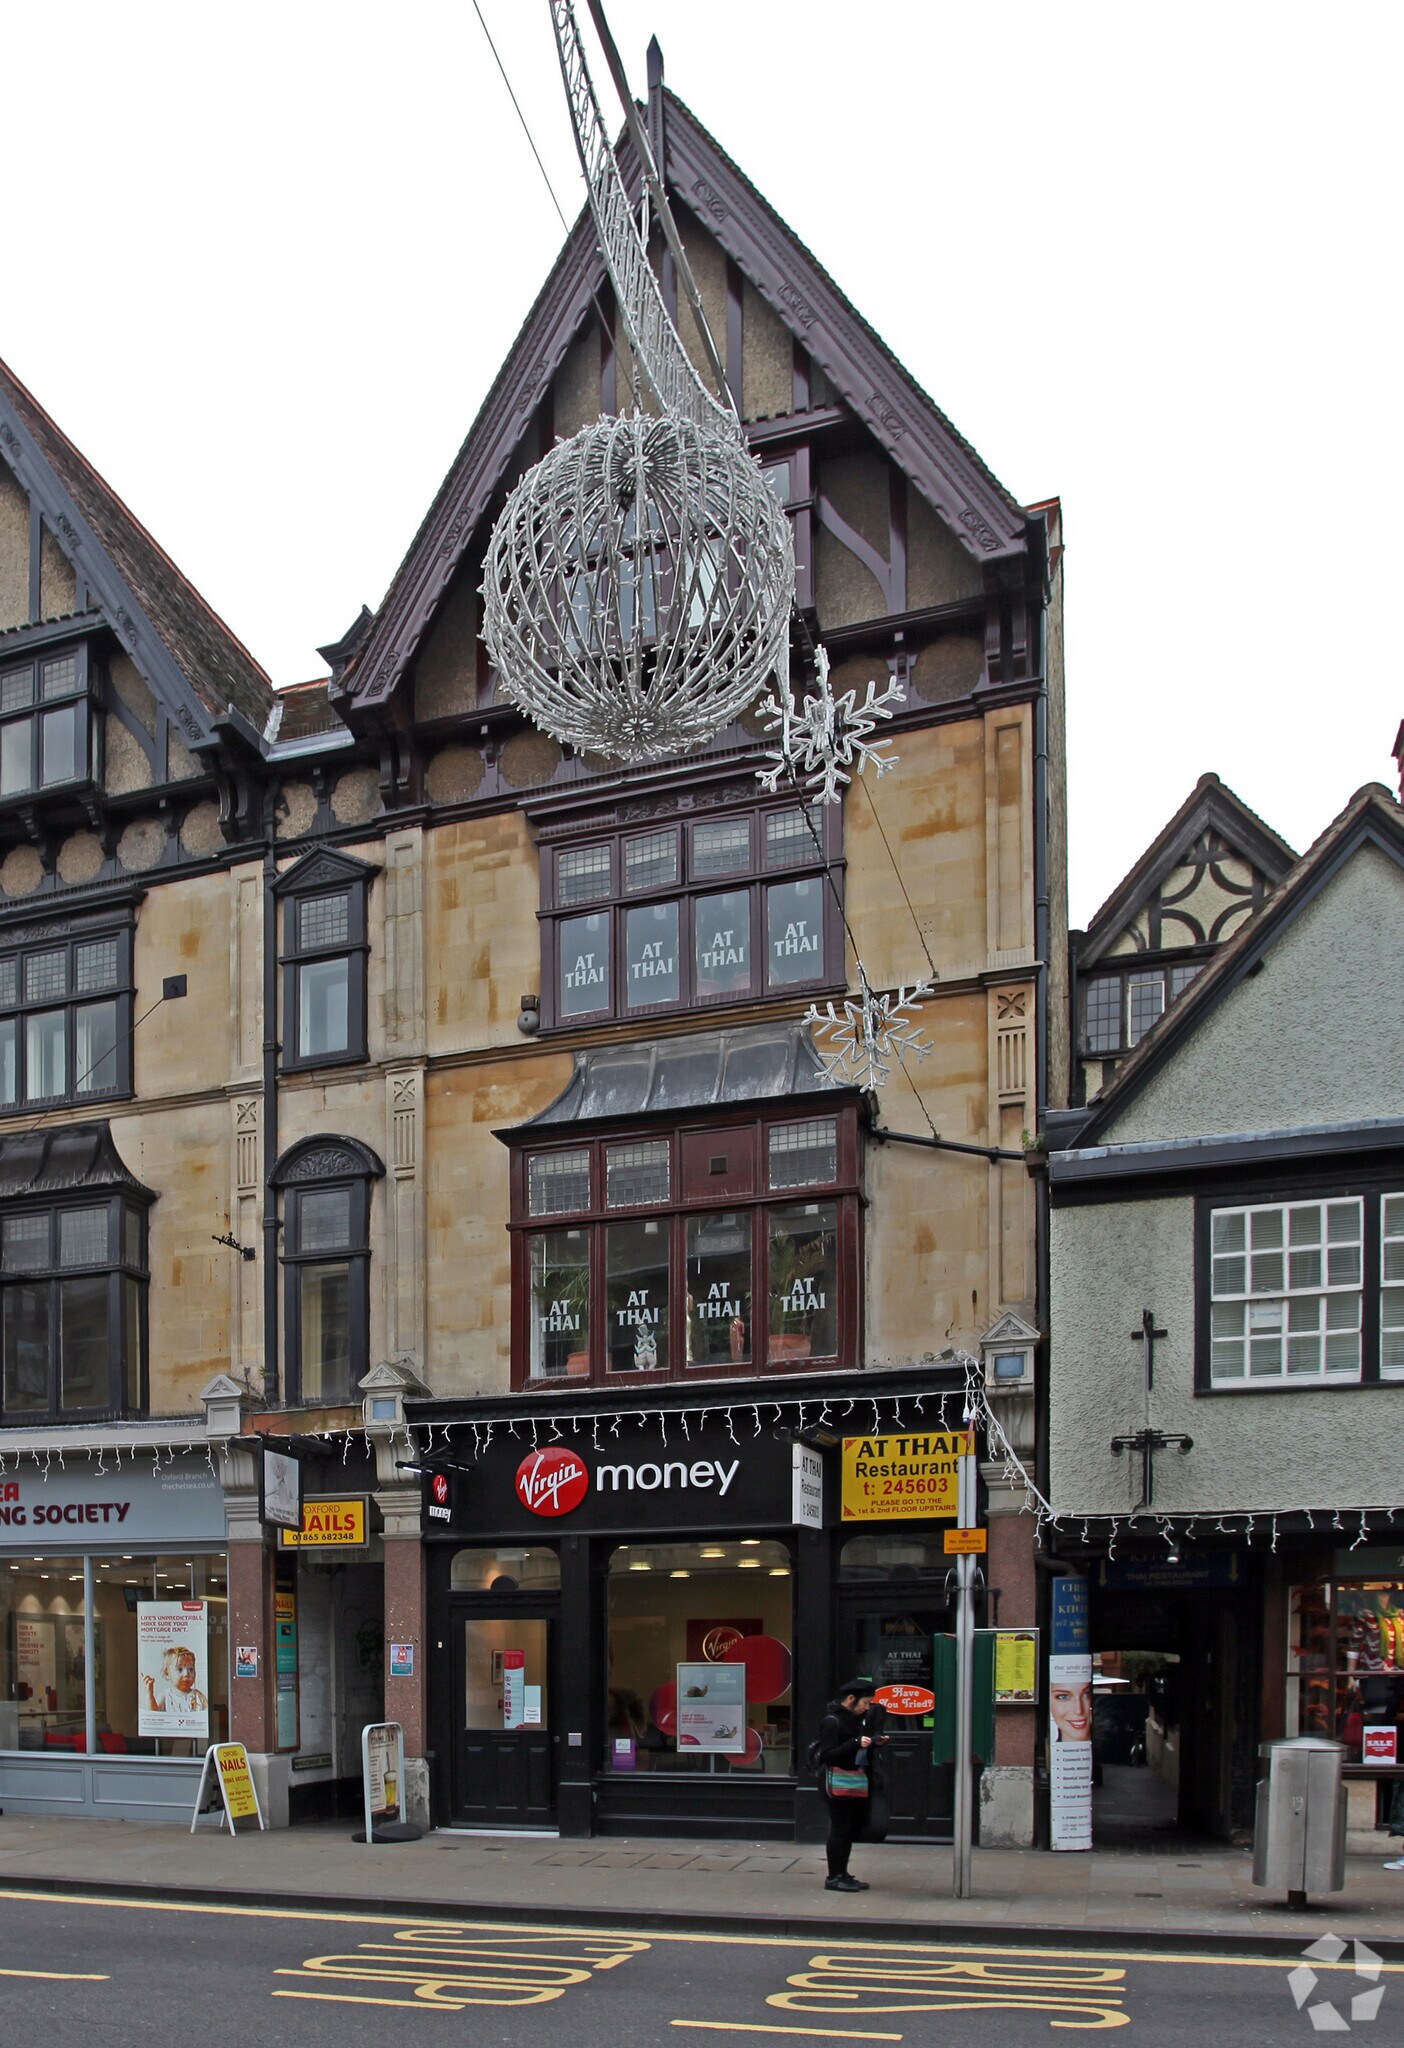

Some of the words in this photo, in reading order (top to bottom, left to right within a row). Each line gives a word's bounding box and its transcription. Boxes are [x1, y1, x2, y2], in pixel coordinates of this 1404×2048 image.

[712, 930, 734, 949] AT
[785, 920, 808, 940] AT
[642, 941, 663, 961] AT
[774, 934, 819, 957] THAI
[574, 953, 595, 972] AT
[701, 947, 745, 968] THAI
[564, 967, 604, 988] THAI
[631, 957, 673, 979] THAI
[708, 1282, 731, 1300] AT
[791, 1277, 815, 1295] AT
[627, 1289, 649, 1307] AT
[780, 1292, 826, 1313] THAI
[549, 1300, 570, 1316] AT
[617, 1306, 659, 1327] THAI
[697, 1300, 741, 1319] THAI
[539, 1314, 580, 1332] THAI
[857, 1439, 889, 1459] AT
[896, 1435, 959, 1457] THAI
[161, 1473, 184, 1481] Oxford
[184, 1472, 208, 1481] Branch
[801, 1456, 809, 1474] AT
[809, 1458, 822, 1479] THAI
[855, 1458, 959, 1478] Restaurant
[161, 1481, 216, 1491] thechelsea.co.uk
[519, 1453, 583, 1510] Virgin
[596, 1459, 740, 1497] money
[863, 1481, 876, 1496] t:
[883, 1478, 949, 1495] 245603
[0, 1482, 20, 1502] A
[304, 1504, 341, 1514] OXFORD
[871, 1499, 901, 1507] PLEASE
[877, 1506, 891, 1514] 2nd
[891, 1505, 918, 1513] FLOOR
[919, 1504, 957, 1512] UPSTAIRS
[33, 1502, 131, 1526] SOCIETY
[429, 1505, 452, 1523] money
[321, 1532, 354, 1541] 682348
[275, 1599, 293, 1609] NAILS
[708, 1633, 738, 1659] Virgin
[887, 1651, 898, 1659] AT
[900, 1651, 922, 1659] THAI
[892, 1686, 920, 1698] Have
[878, 1698, 899, 1709] You
[901, 1698, 933, 1709] Tried?
[219, 1757, 247, 1773] NAILS
[272, 1929, 653, 2006] STOP
[765, 1955, 1131, 2029] BUS
